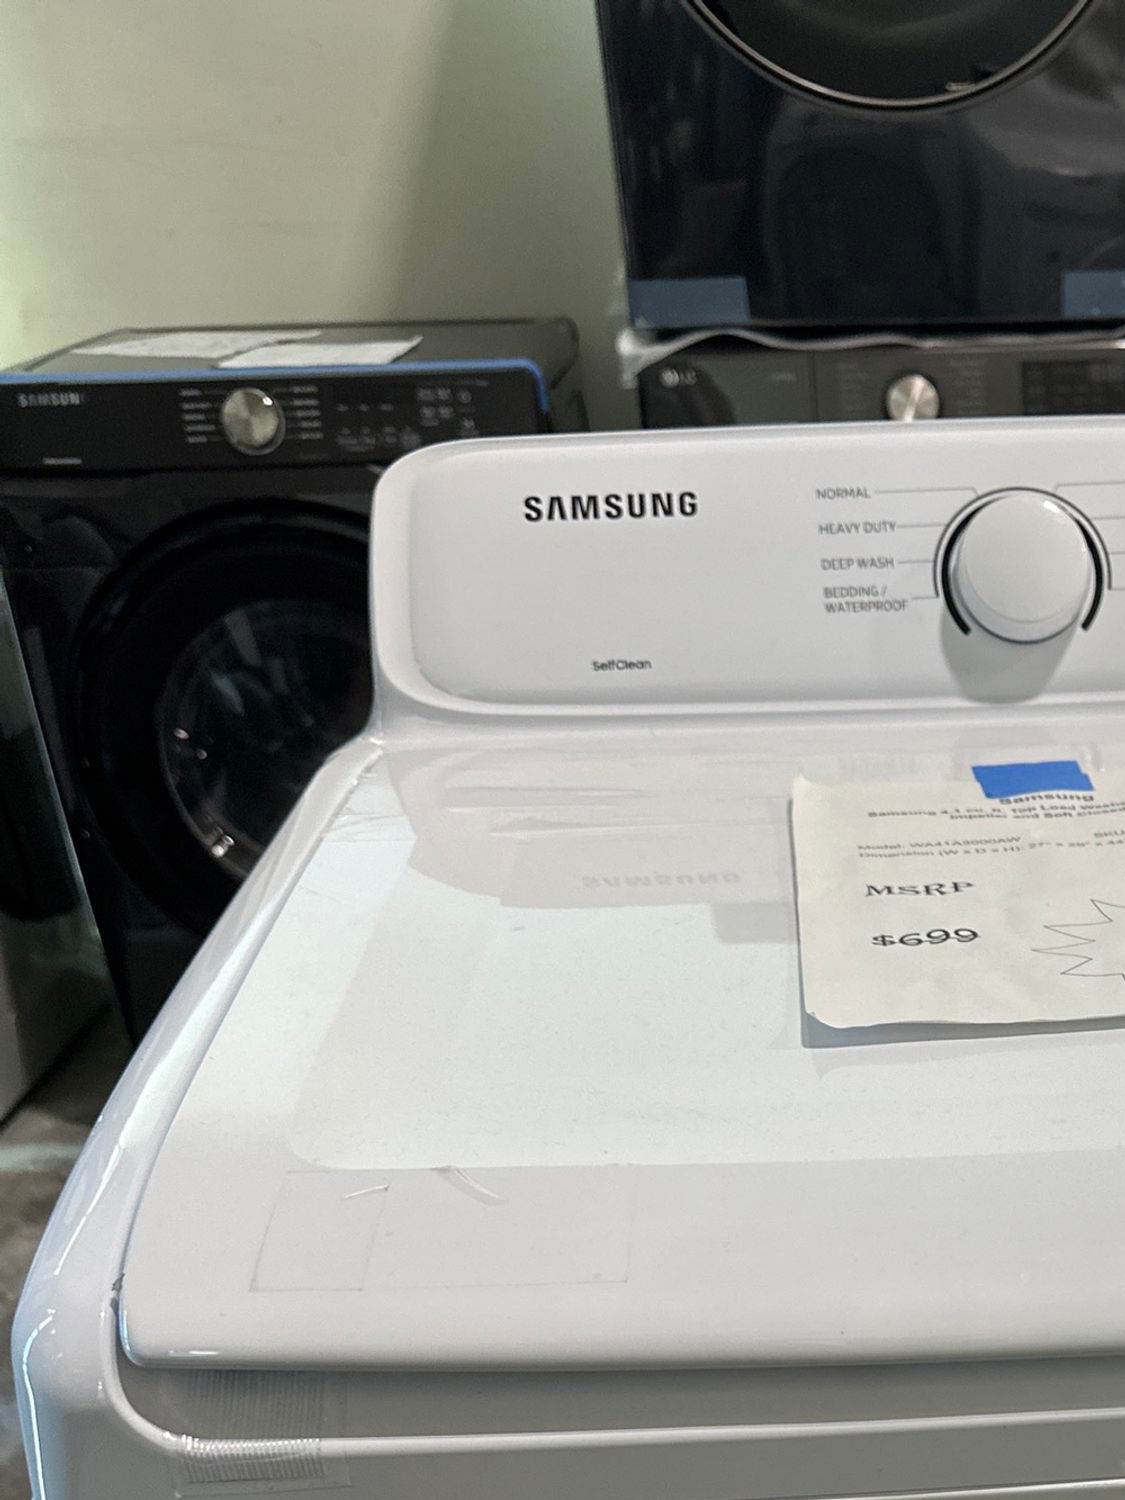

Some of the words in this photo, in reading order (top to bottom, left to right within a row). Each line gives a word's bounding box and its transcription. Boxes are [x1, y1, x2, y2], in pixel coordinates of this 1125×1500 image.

[17, 392, 86, 408] SAMSUN
[815, 487, 871, 500] NORMAL
[523, 490, 698, 522] SAMSUNG
[818, 522, 860, 535] HEAVY
[863, 521, 896, 533] DUTY
[820, 558, 854, 571] DEEP
[856, 557, 894, 569] WASH
[823, 586, 879, 599] BEDDING
[824, 599, 907, 614] WATERPROOF
[592, 659, 652, 671] SelfClean
[1000, 793, 1094, 804] Samsung
[867, 808, 936, 817] Samsung
[1011, 805, 1037, 814] Top
[1040, 803, 1076, 812] Load
[1044, 811, 1073, 819] Soft
[865, 881, 974, 896] MSRP
[872, 928, 979, 946] $699
